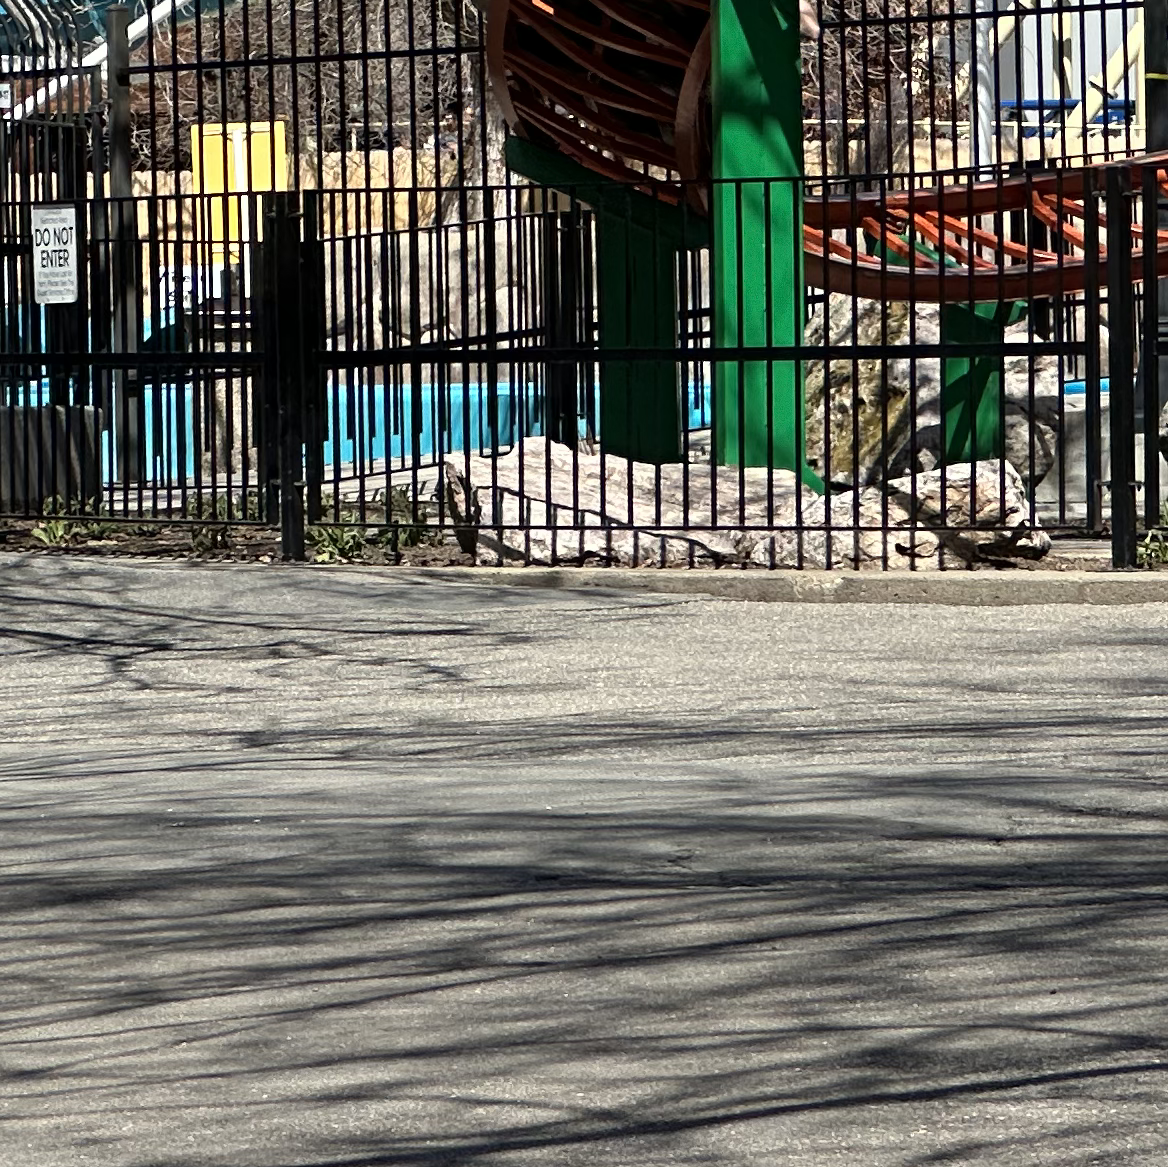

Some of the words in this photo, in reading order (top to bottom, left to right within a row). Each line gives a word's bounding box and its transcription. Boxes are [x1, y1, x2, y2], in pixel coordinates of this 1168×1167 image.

[34, 227, 51, 247] DO
[53, 226, 74, 246] NOT
[40, 248, 70, 269] ENTER
